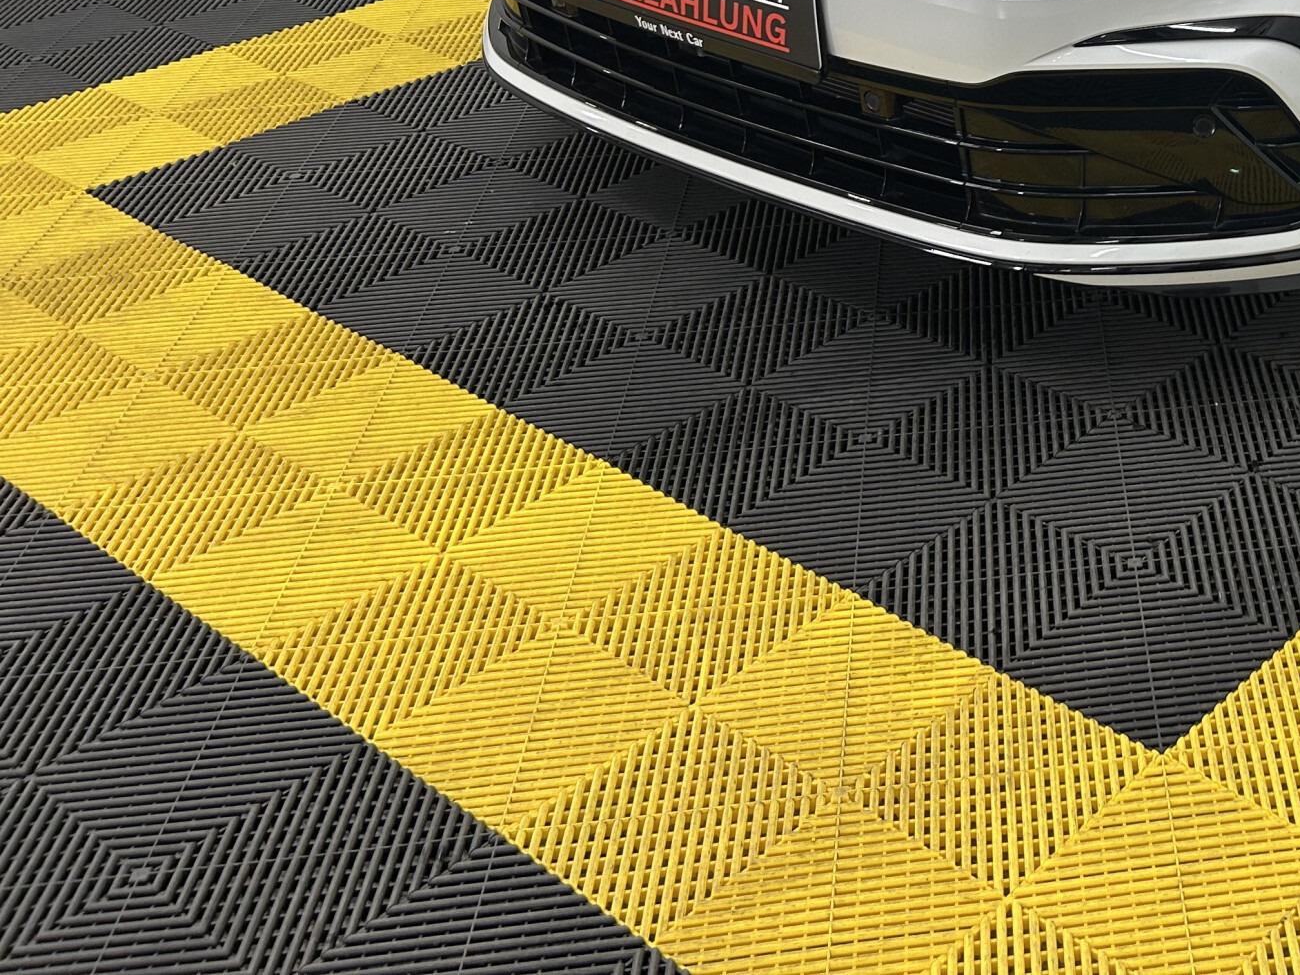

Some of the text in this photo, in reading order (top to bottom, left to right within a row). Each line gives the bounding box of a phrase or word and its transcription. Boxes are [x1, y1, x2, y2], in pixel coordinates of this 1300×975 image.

[634, 15, 704, 48] Your Next Car
